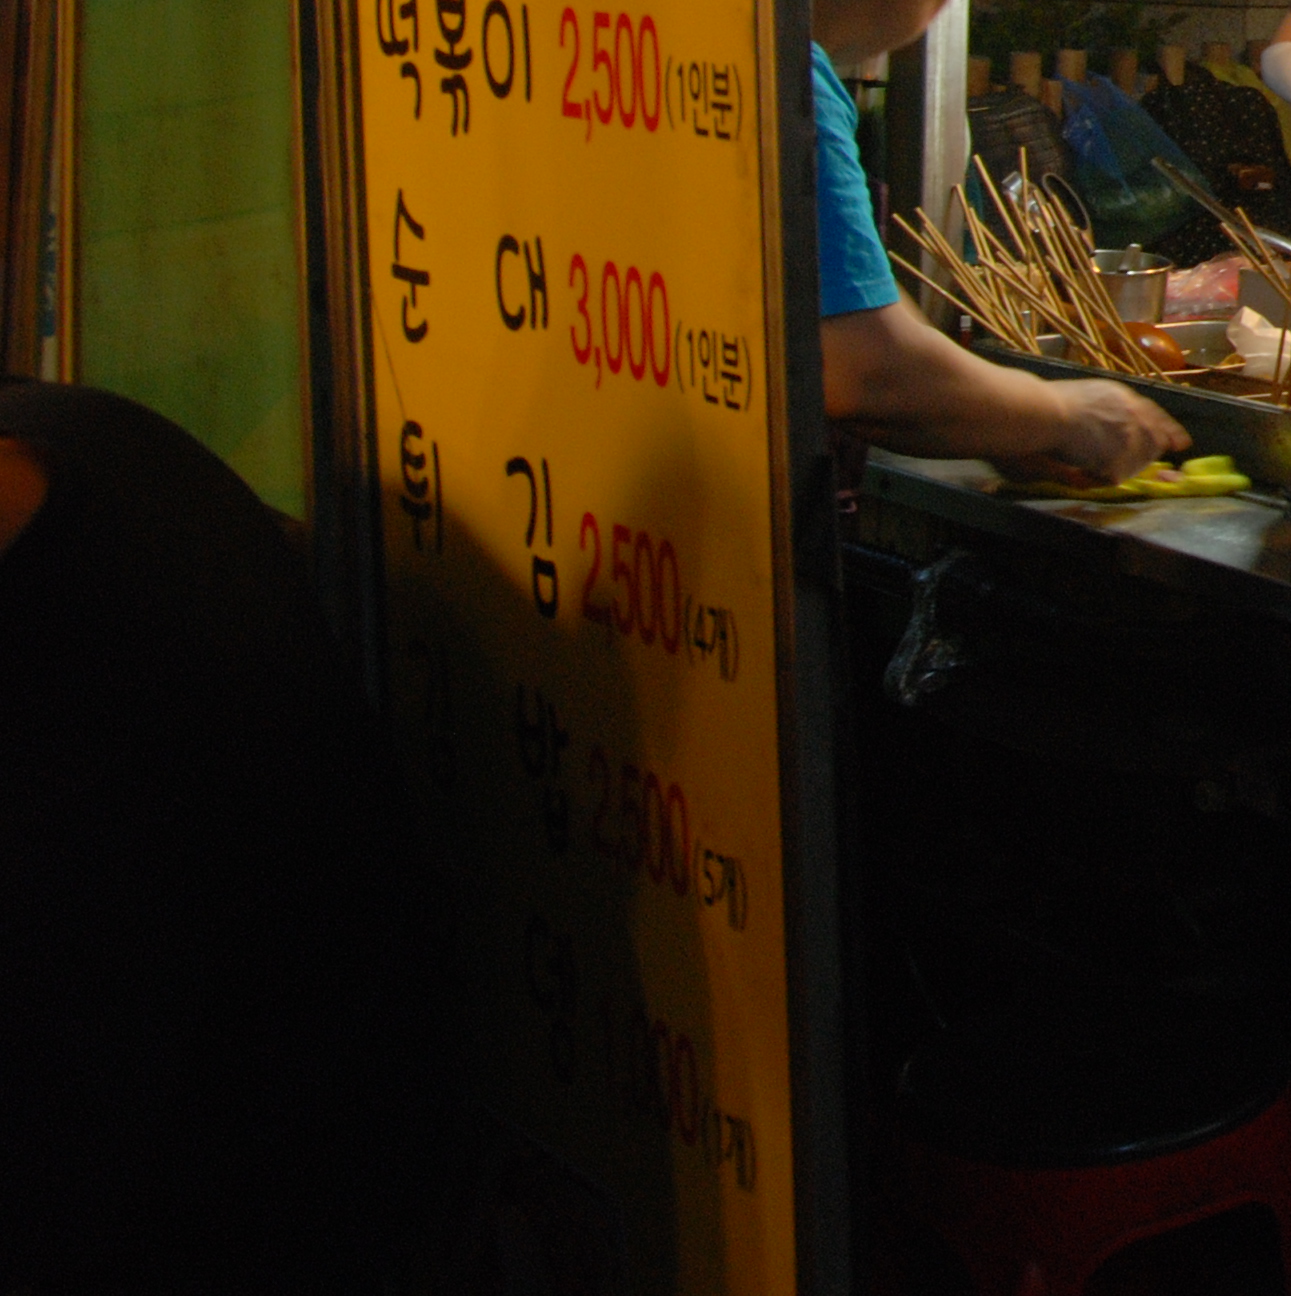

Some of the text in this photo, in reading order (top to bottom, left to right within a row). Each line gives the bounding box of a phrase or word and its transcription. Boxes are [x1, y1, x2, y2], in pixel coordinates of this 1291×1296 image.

[559, 7, 662, 143] 2,500
[664, 55, 742, 142] (1인분)
[569, 253, 670, 390] 3,000
[675, 320, 752, 412] (1인분)
[579, 510, 682, 660] 2,500
